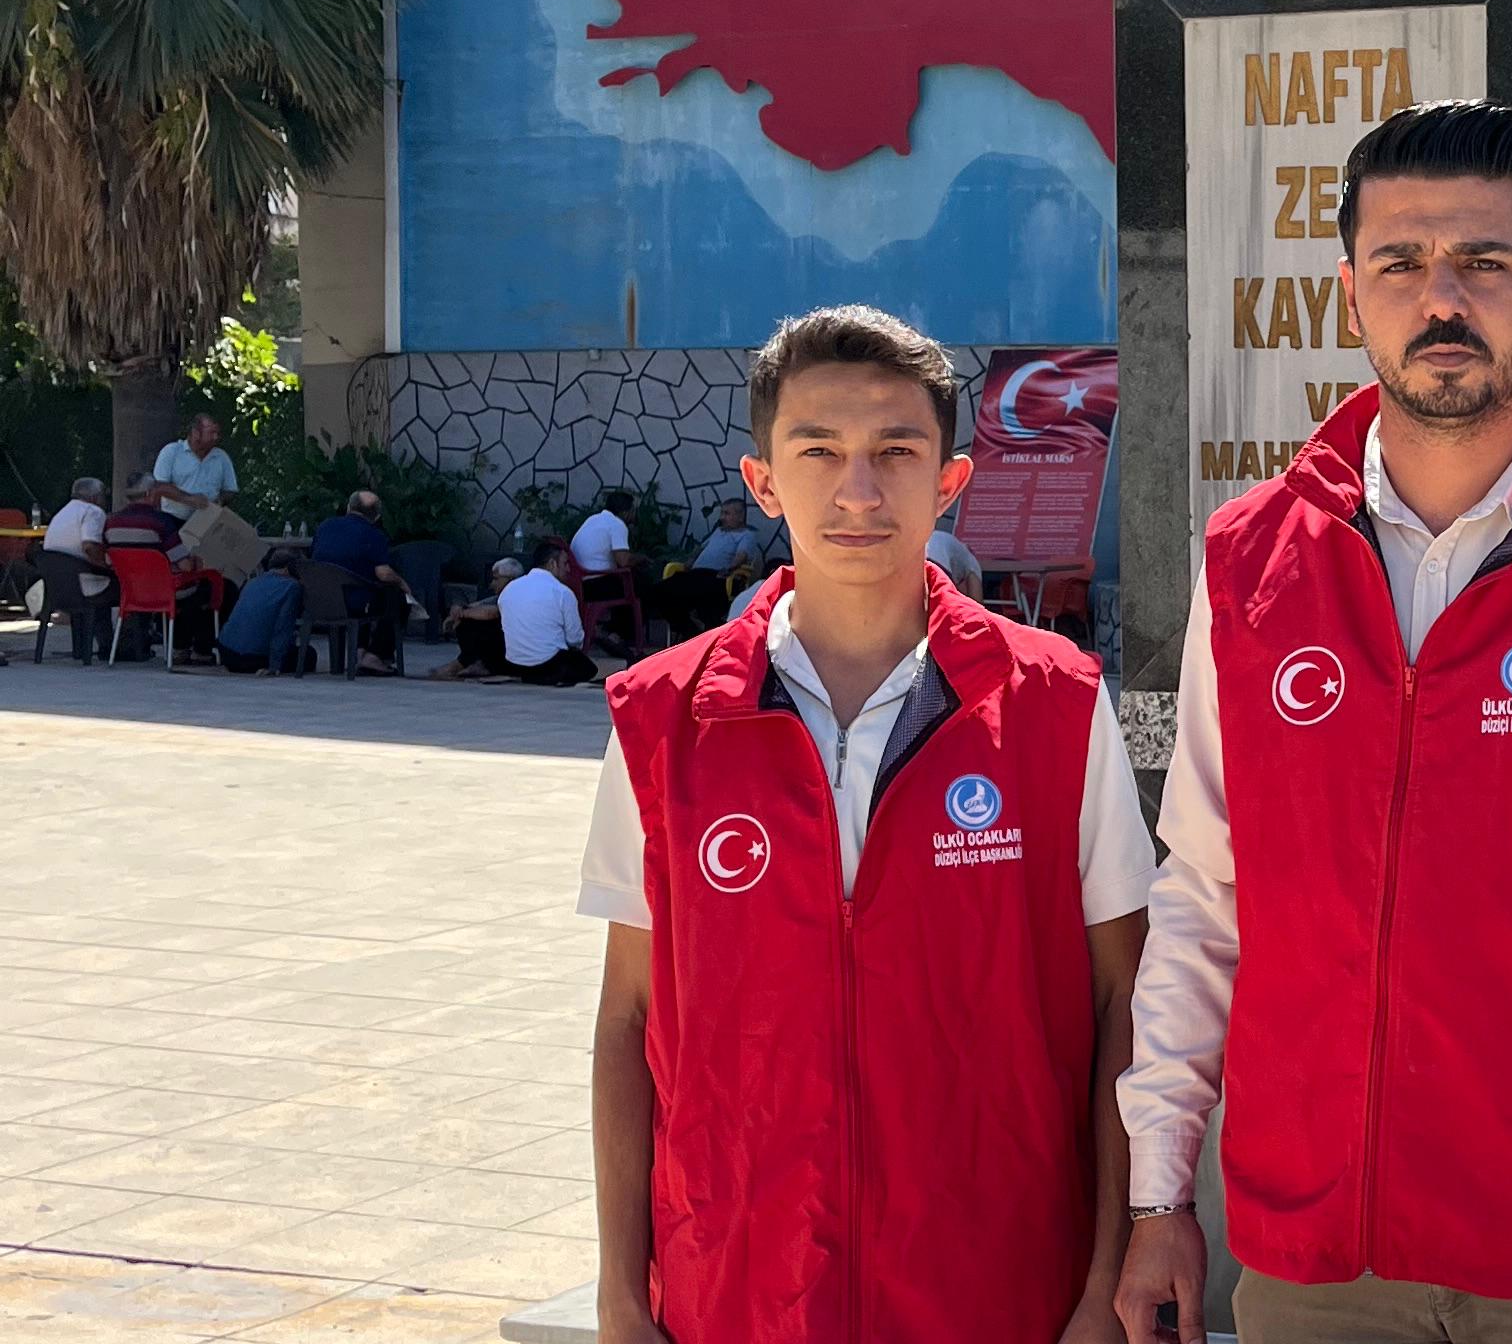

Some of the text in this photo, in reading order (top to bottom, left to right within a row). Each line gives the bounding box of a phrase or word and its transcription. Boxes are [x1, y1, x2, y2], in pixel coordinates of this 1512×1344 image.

[1243, 47, 1414, 127] NAFTA
[933, 828, 1022, 850] ÜLKÜ OCAKLARI
